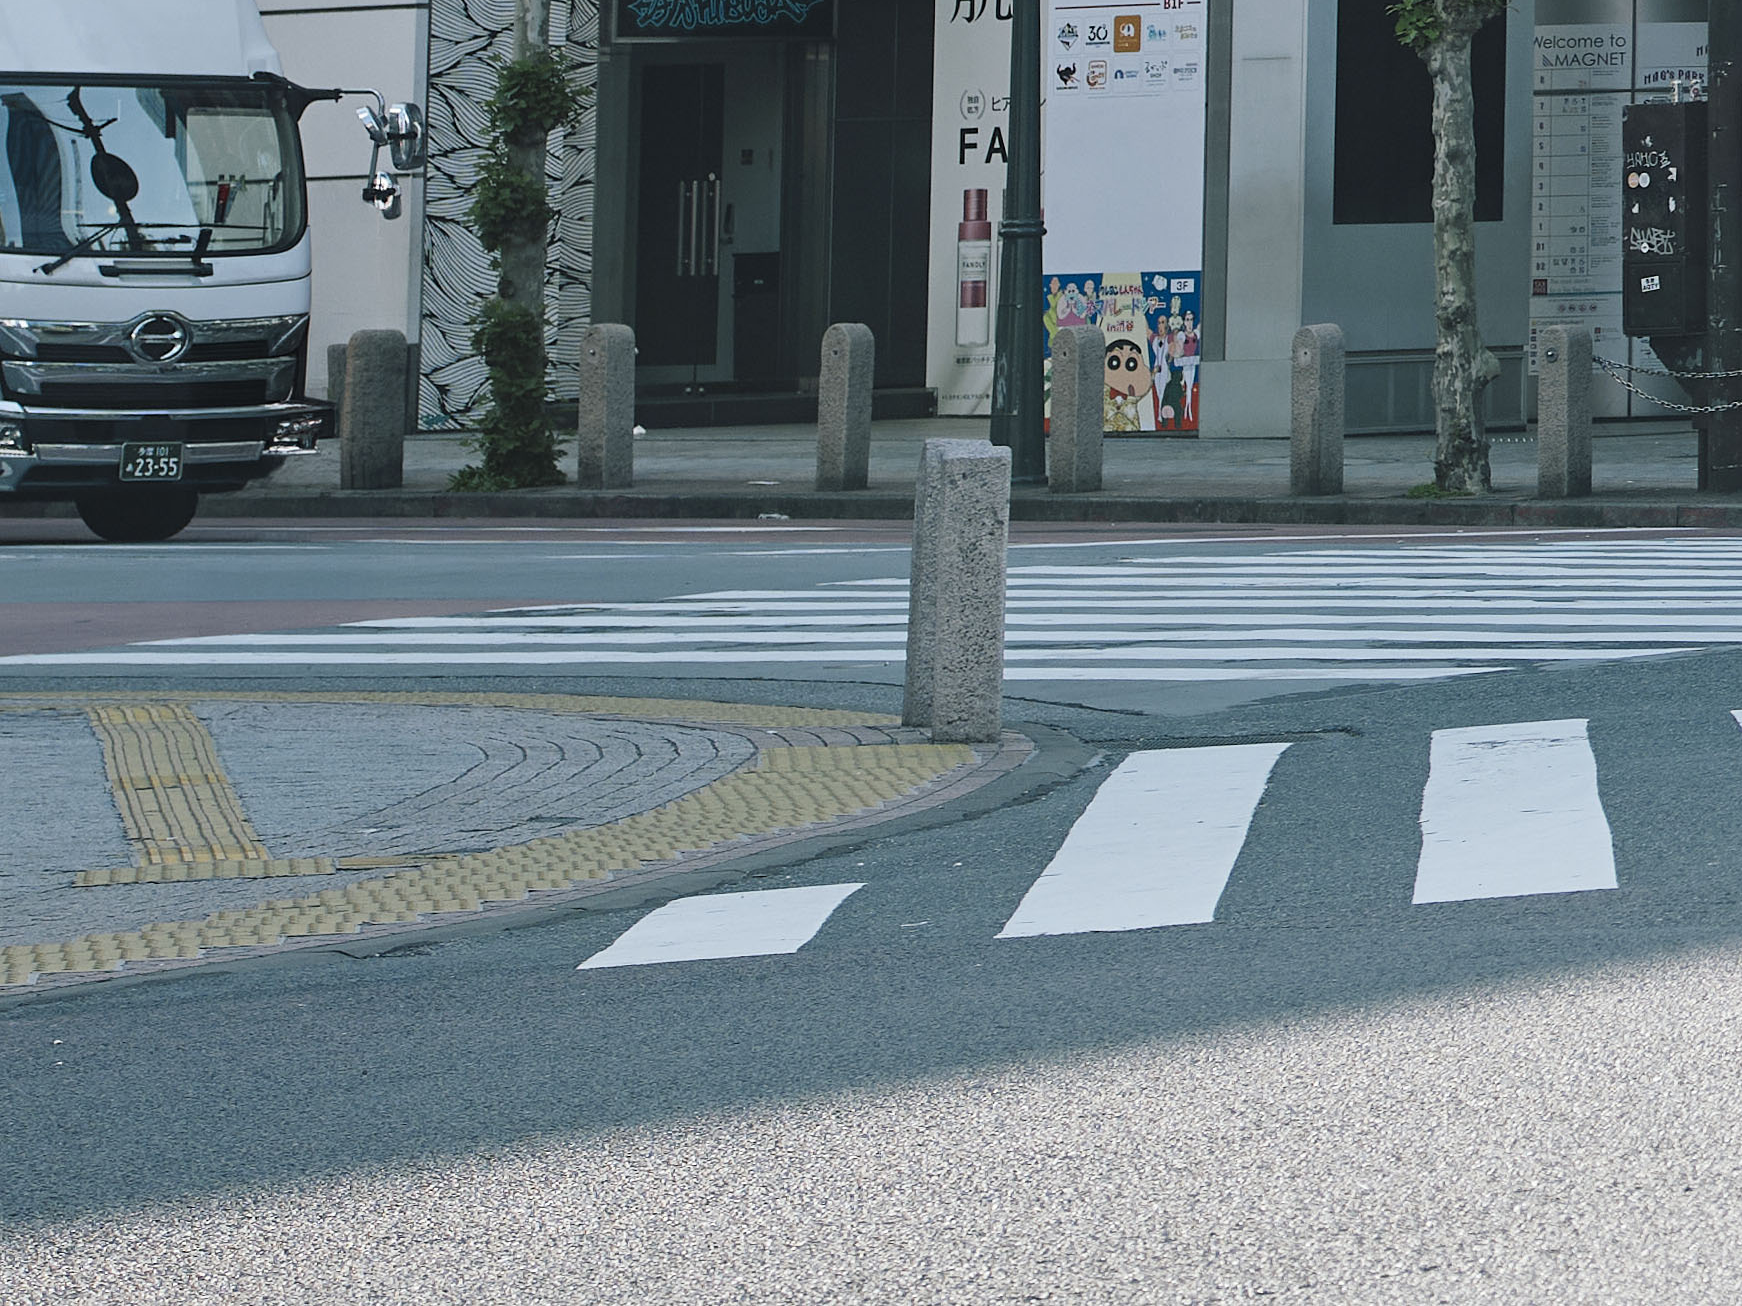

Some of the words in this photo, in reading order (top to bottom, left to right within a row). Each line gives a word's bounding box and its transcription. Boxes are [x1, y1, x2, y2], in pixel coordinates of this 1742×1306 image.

[1534, 35, 1603, 49] Welcome
[1610, 33, 1627, 48] to
[1554, 51, 1627, 68] MAGNET
[1176, 280, 1189, 292] 3F
[156, 447, 169, 457] 101
[134, 458, 179, 477] 23-55
